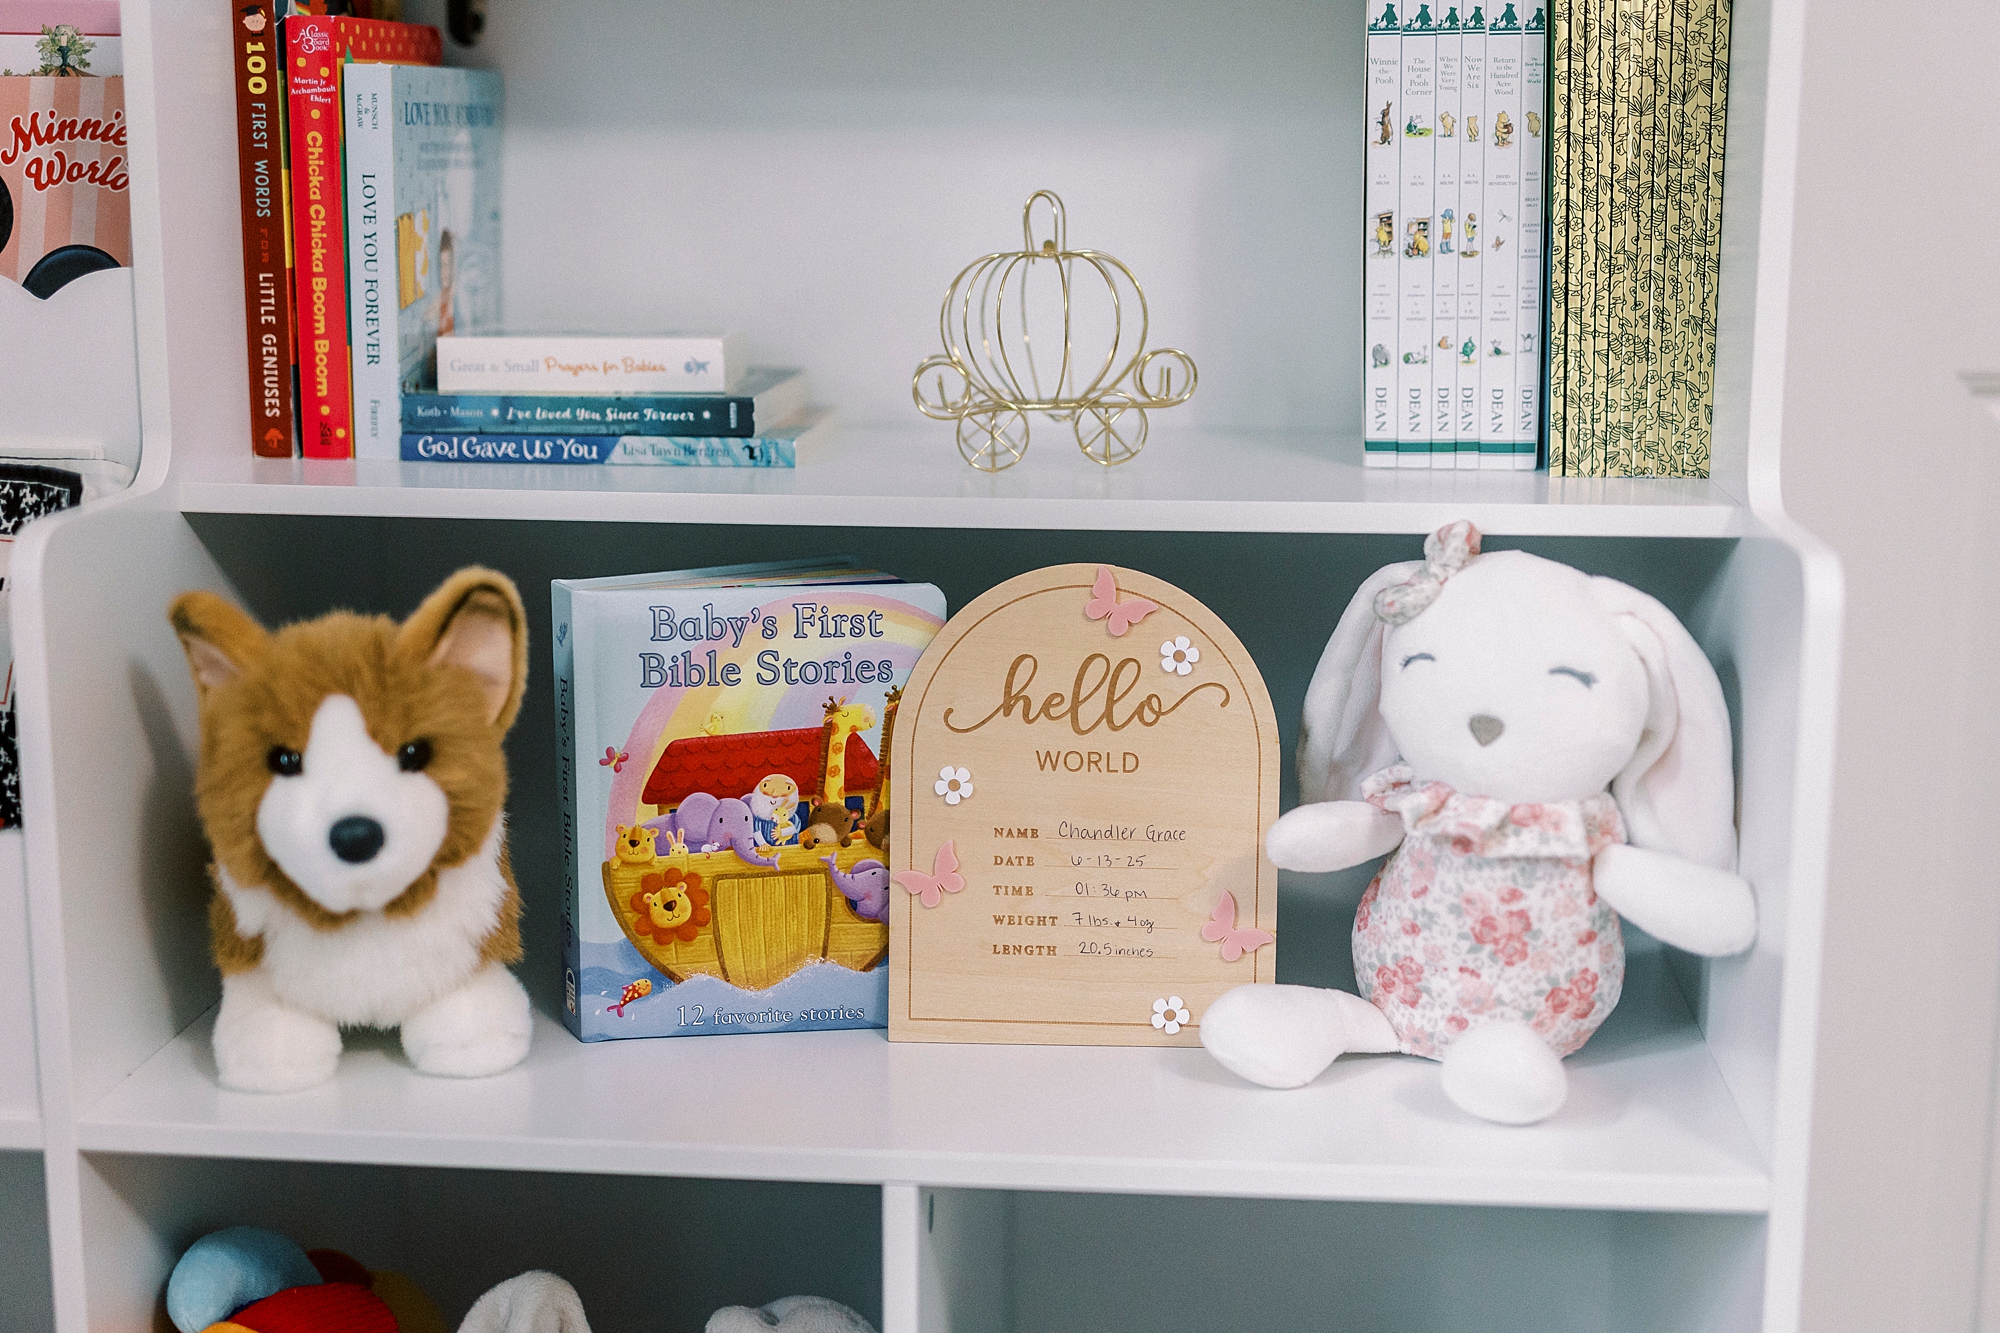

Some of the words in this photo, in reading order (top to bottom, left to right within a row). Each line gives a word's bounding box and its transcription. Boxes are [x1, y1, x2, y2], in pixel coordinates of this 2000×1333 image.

[246, 42, 267, 95] 100
[1370, 58, 1399, 66] Winnie
[1407, 65, 1431, 73] House
[1464, 55, 1483, 63] Now
[291, 86, 336, 95] Archambault
[293, 77, 318, 85] Martin
[1375, 76, 1394, 84] Pooh
[1405, 88, 1433, 96] Corner
[1410, 79, 1429, 87] Pooh
[310, 95, 331, 104] Ehlert
[356, 93, 364, 128] McGRAW
[371, 92, 379, 130] MUNSCH
[1, 110, 127, 164] Minnie
[252, 103, 268, 149] FIRST
[306, 130, 324, 200] Chicka
[255, 160, 271, 218] WORDS
[362, 173, 377, 225] LOVE
[260, 228, 269, 263] FOR
[309, 204, 327, 273] Chicka
[363, 231, 378, 273] YOU
[312, 277, 327, 335] Boom
[364, 279, 380, 366] FOREVER
[262, 333, 281, 418] GENIUSES
[315, 339, 330, 397] Boom
[449, 358, 485, 373] Great
[504, 358, 539, 373] Small
[544, 356, 599, 377] Prayers
[603, 361, 619, 376] for
[621, 356, 667, 374] Babies
[507, 406, 531, 421] I've
[535, 406, 572, 421] Loved
[576, 407, 601, 422] You
[605, 407, 640, 422] Since
[643, 407, 695, 421] Forever
[1375, 387, 1387, 432] DEAN
[1409, 388, 1421, 433] DEAN
[1437, 387, 1449, 432] DEAN
[1461, 387, 1473, 432] DEAN
[1491, 388, 1503, 434] DEAN
[1520, 389, 1533, 431] DEAN
[417, 435, 459, 460] God
[462, 436, 520, 459] Gave
[556, 438, 599, 460] You
[792, 602, 884, 639] First
[638, 649, 742, 688] Bible
[756, 649, 894, 686] Stories
[559, 676, 571, 748] Baby's
[943, 653, 1230, 735] hello
[561, 755, 572, 801] First
[1035, 750, 1140, 773] WORLD
[562, 810, 572, 866] Bible
[993, 827, 1039, 839] NAME
[1058, 820, 1137, 840] Chandler
[1145, 824, 1187, 843] Grace
[993, 855, 1035, 867] DATE
[993, 885, 1034, 897] TIME
[564, 876, 573, 948] Stories
[992, 914, 1059, 927] WEIGHT
[1071, 912, 1083, 925] 7
[1127, 915, 1137, 927] 4
[992, 944, 1057, 957] LENGTH
[1079, 941, 1112, 956] 20.5
[1115, 944, 1154, 958] inches
[676, 1005, 705, 1027] 12
[712, 1007, 794, 1025] favorite
[799, 1004, 865, 1022] stories
